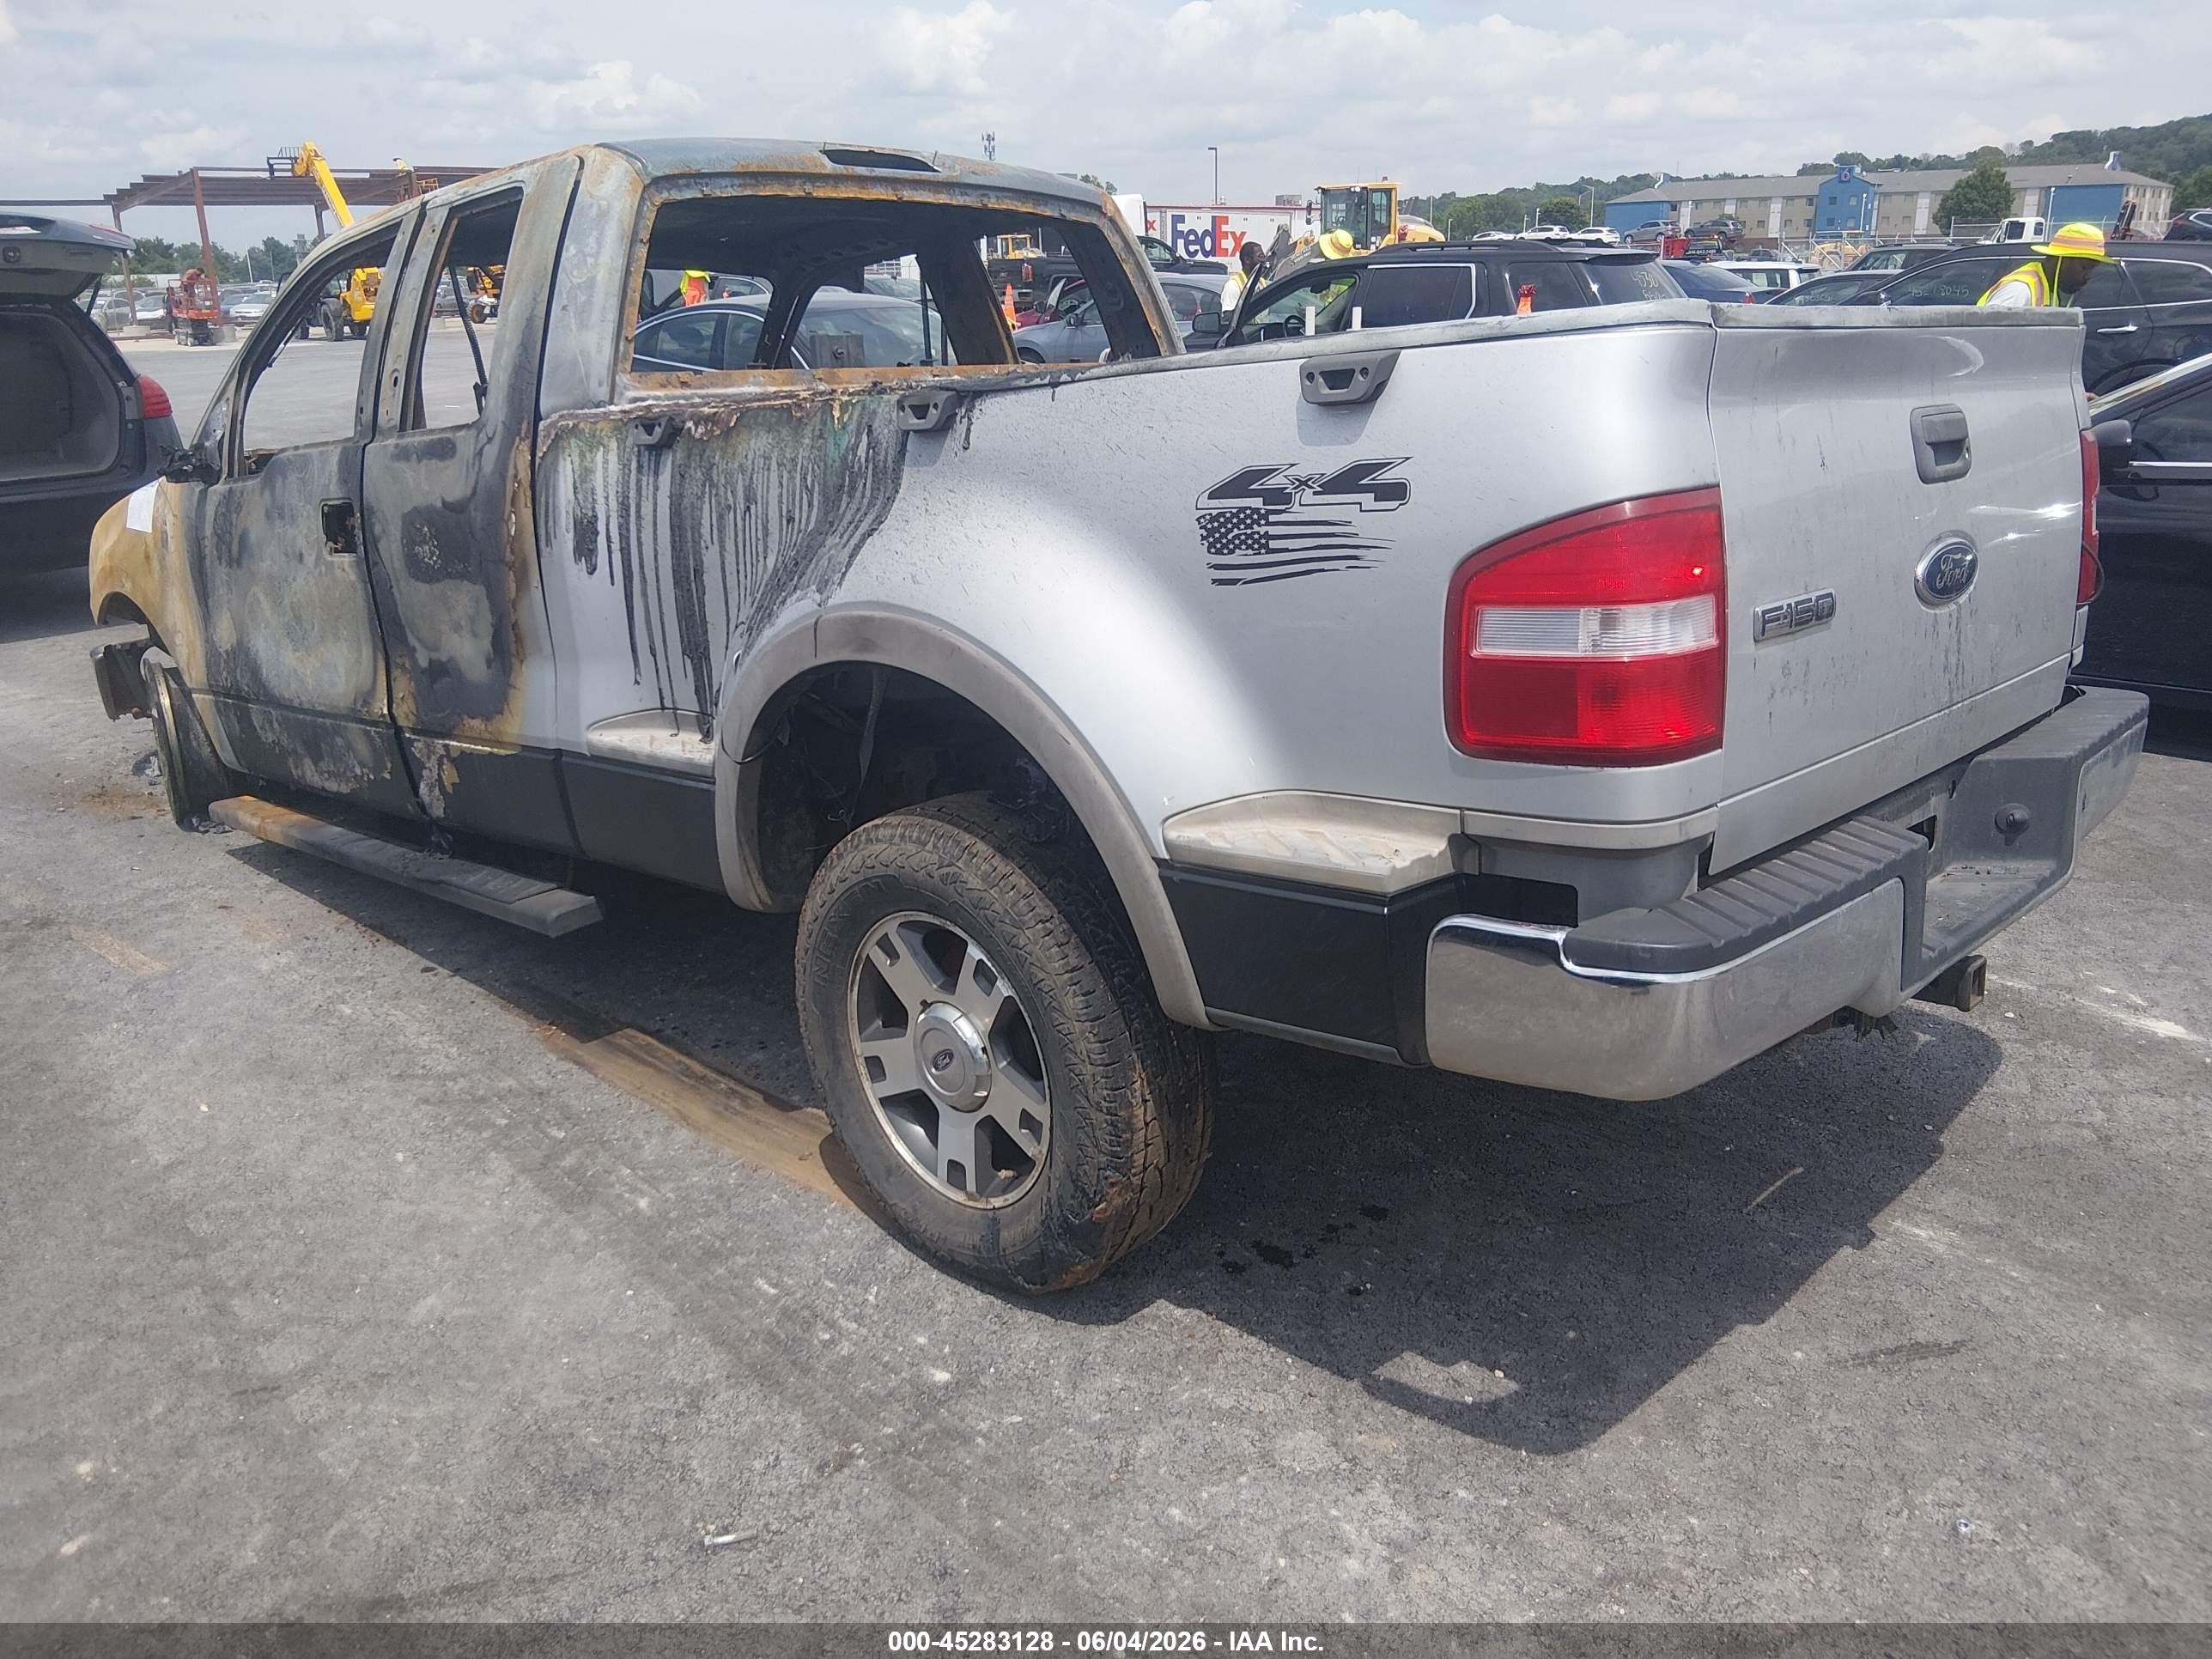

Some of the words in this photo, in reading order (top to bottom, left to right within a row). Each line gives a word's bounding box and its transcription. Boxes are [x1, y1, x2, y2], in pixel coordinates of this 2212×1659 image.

[1170, 214, 1248, 258] FedEx
[1196, 456, 1414, 513] 4x4
[1936, 552, 1973, 590] Ford
